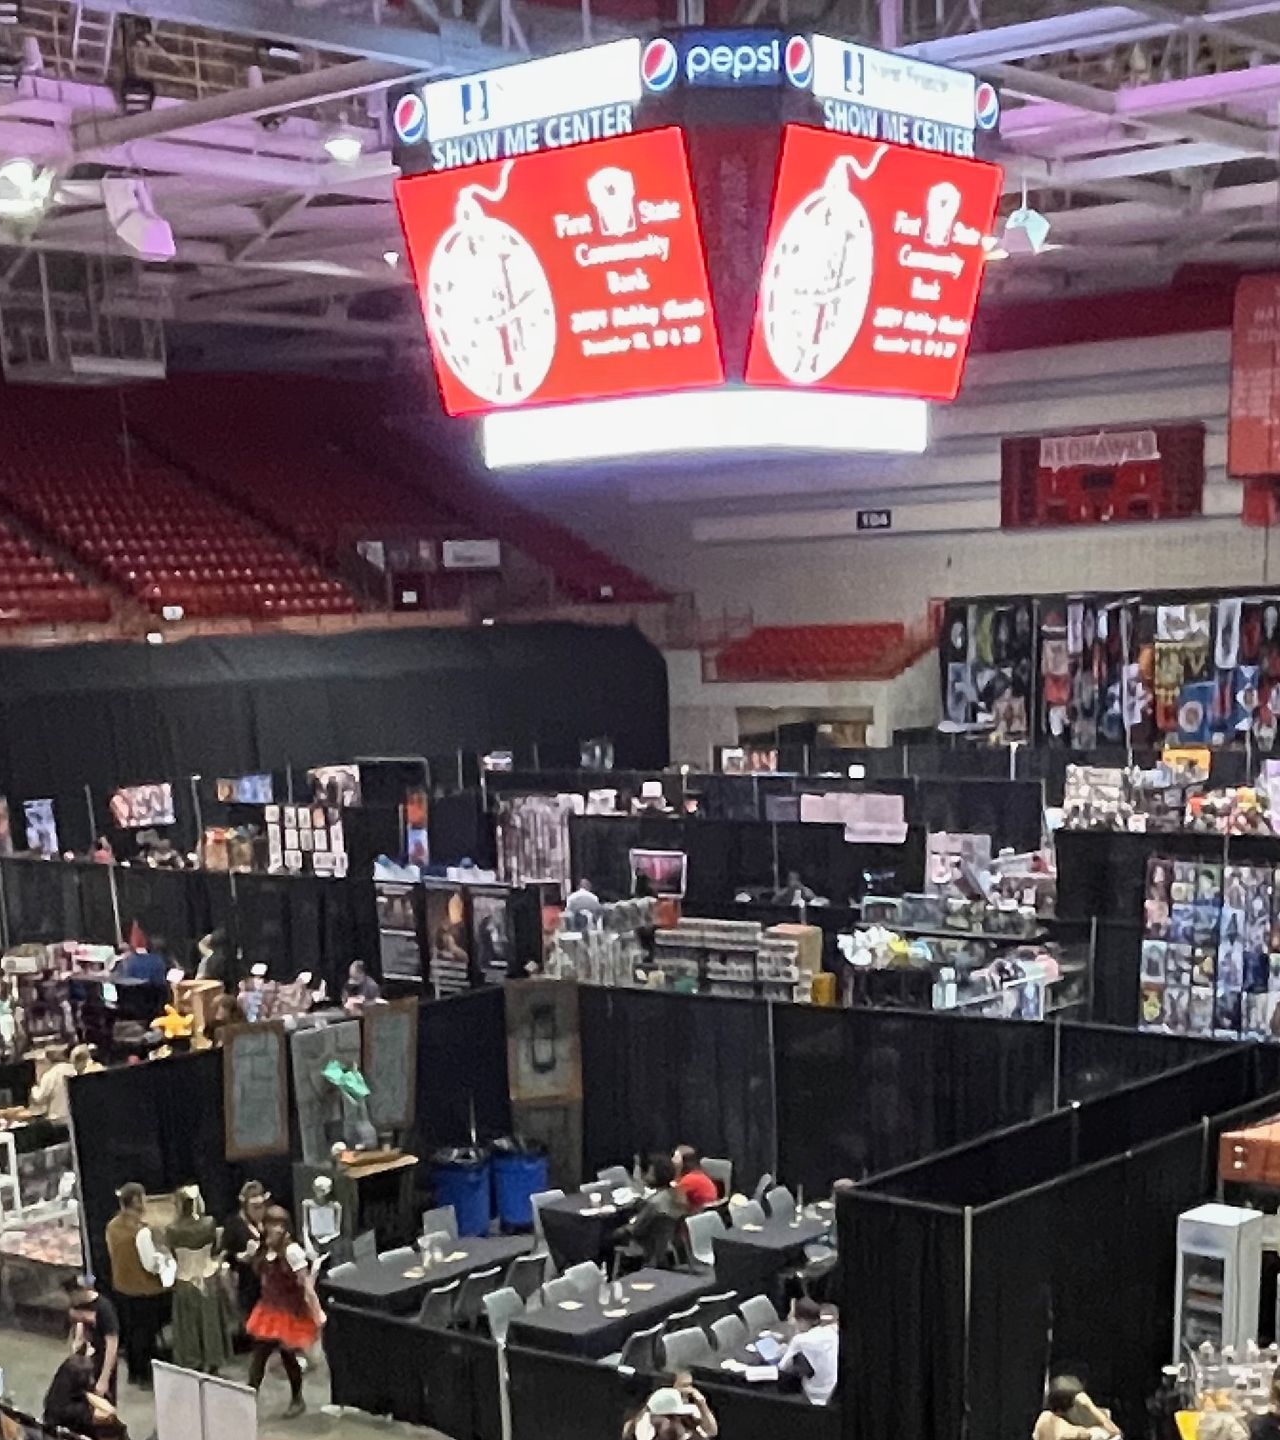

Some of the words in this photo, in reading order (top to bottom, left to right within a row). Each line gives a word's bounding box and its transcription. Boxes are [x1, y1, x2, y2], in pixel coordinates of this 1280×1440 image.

[686, 39, 780, 84] pepsi
[431, 129, 499, 171] SHOW
[504, 122, 540, 157] ME
[545, 104, 633, 148] CENTER
[823, 99, 878, 138] SHOW
[881, 110, 910, 145] ME
[912, 119, 975, 160] CENTER
